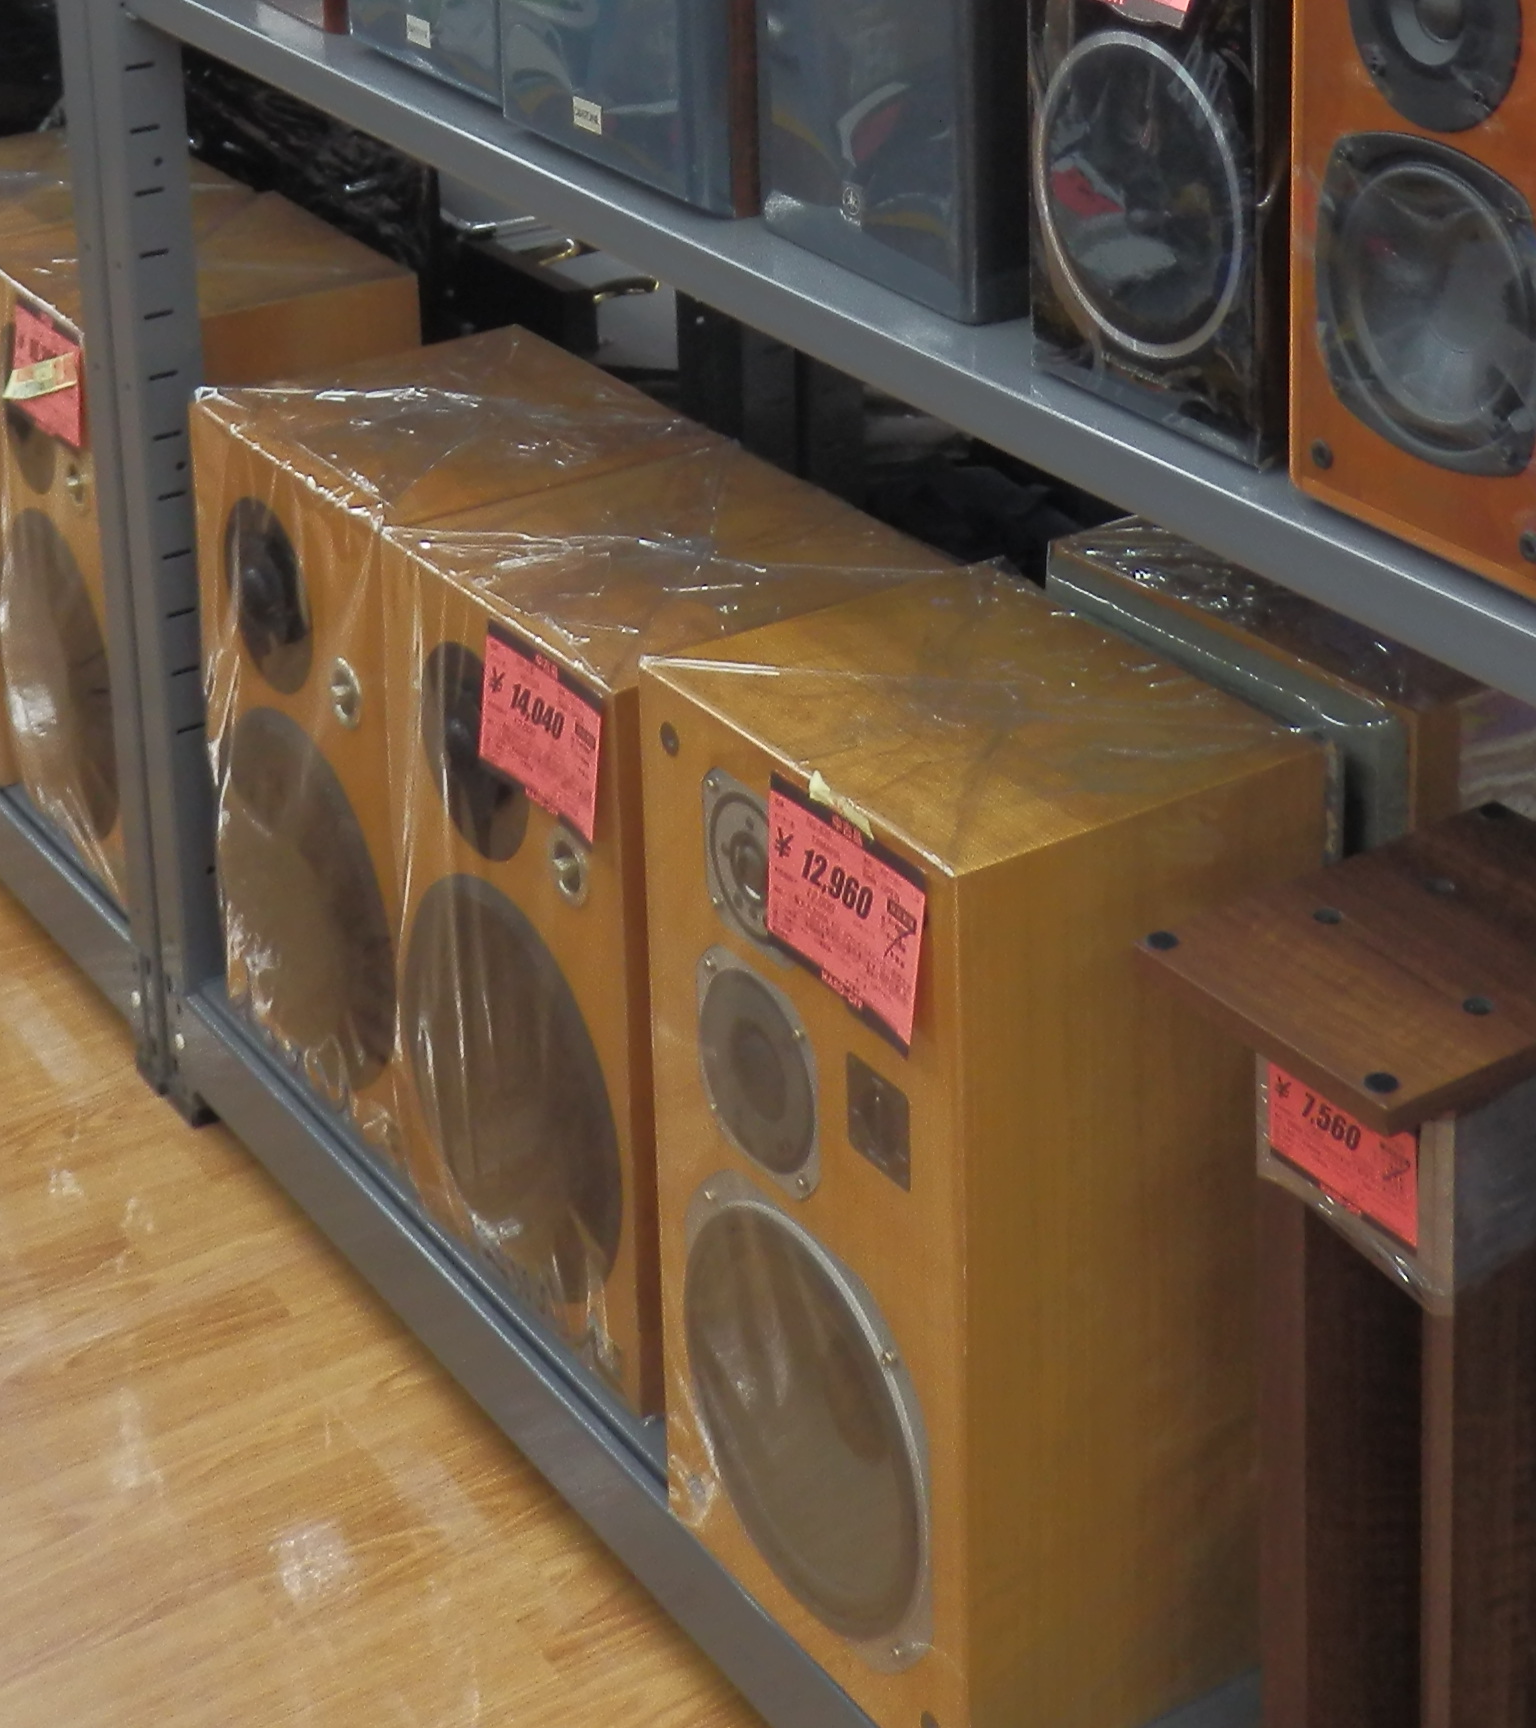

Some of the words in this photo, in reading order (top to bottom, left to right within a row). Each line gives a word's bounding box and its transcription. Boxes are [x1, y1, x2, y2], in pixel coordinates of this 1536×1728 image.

[488, 666, 506, 695] ¥
[509, 681, 567, 739] 14,040
[773, 829, 793, 860] ¥
[800, 847, 875, 921] 12,960
[1273, 1074, 1292, 1100] ¥
[1300, 1095, 1363, 1154] 7,560
